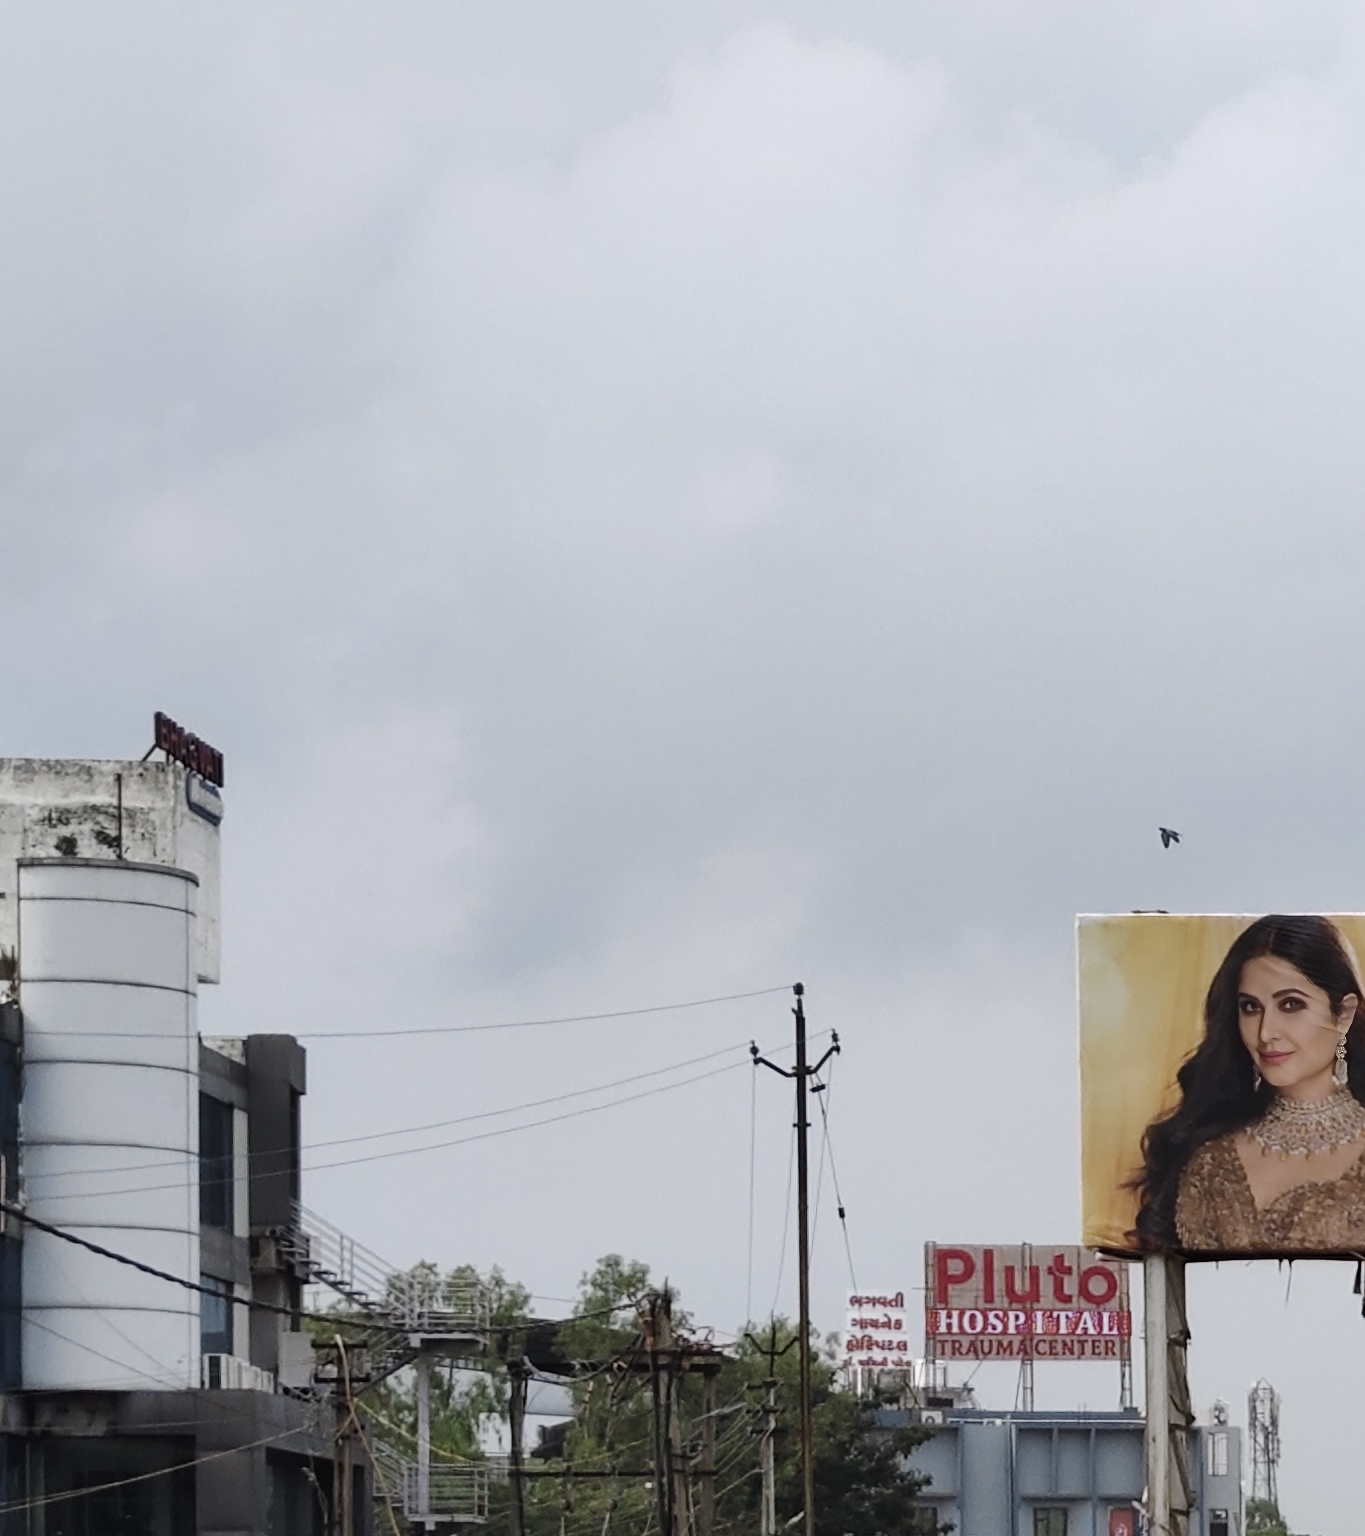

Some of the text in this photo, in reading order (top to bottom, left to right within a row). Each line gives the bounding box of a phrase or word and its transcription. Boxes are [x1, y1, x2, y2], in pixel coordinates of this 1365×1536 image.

[935, 1248, 1118, 1305] Pluto
[937, 1310, 1120, 1335] HOSPITAL
[938, 1339, 1117, 1357] TRAUMA CENTER
